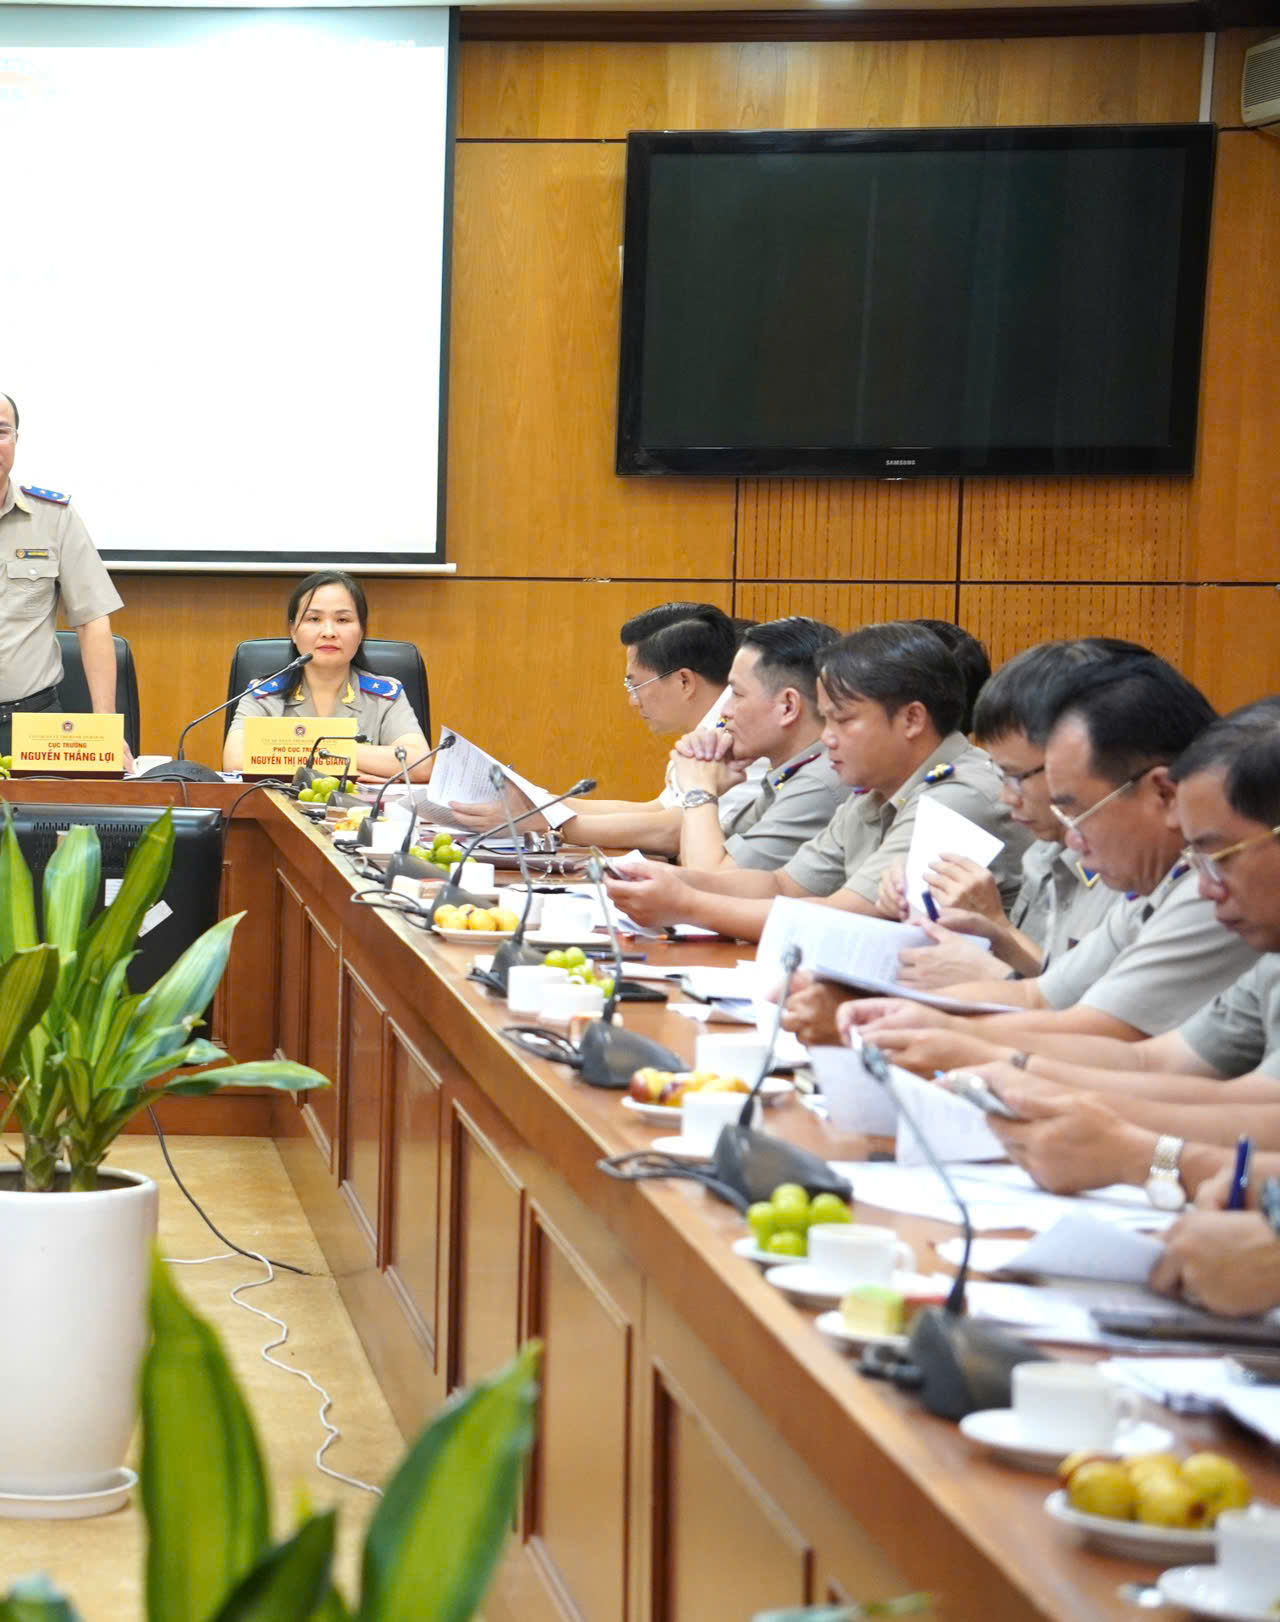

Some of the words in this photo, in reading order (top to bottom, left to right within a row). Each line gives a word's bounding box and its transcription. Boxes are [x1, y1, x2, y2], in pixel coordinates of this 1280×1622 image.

[99, 752, 114, 763] LỢI
[284, 756, 295, 767] THỊ
[297, 756, 324, 765] HONG
